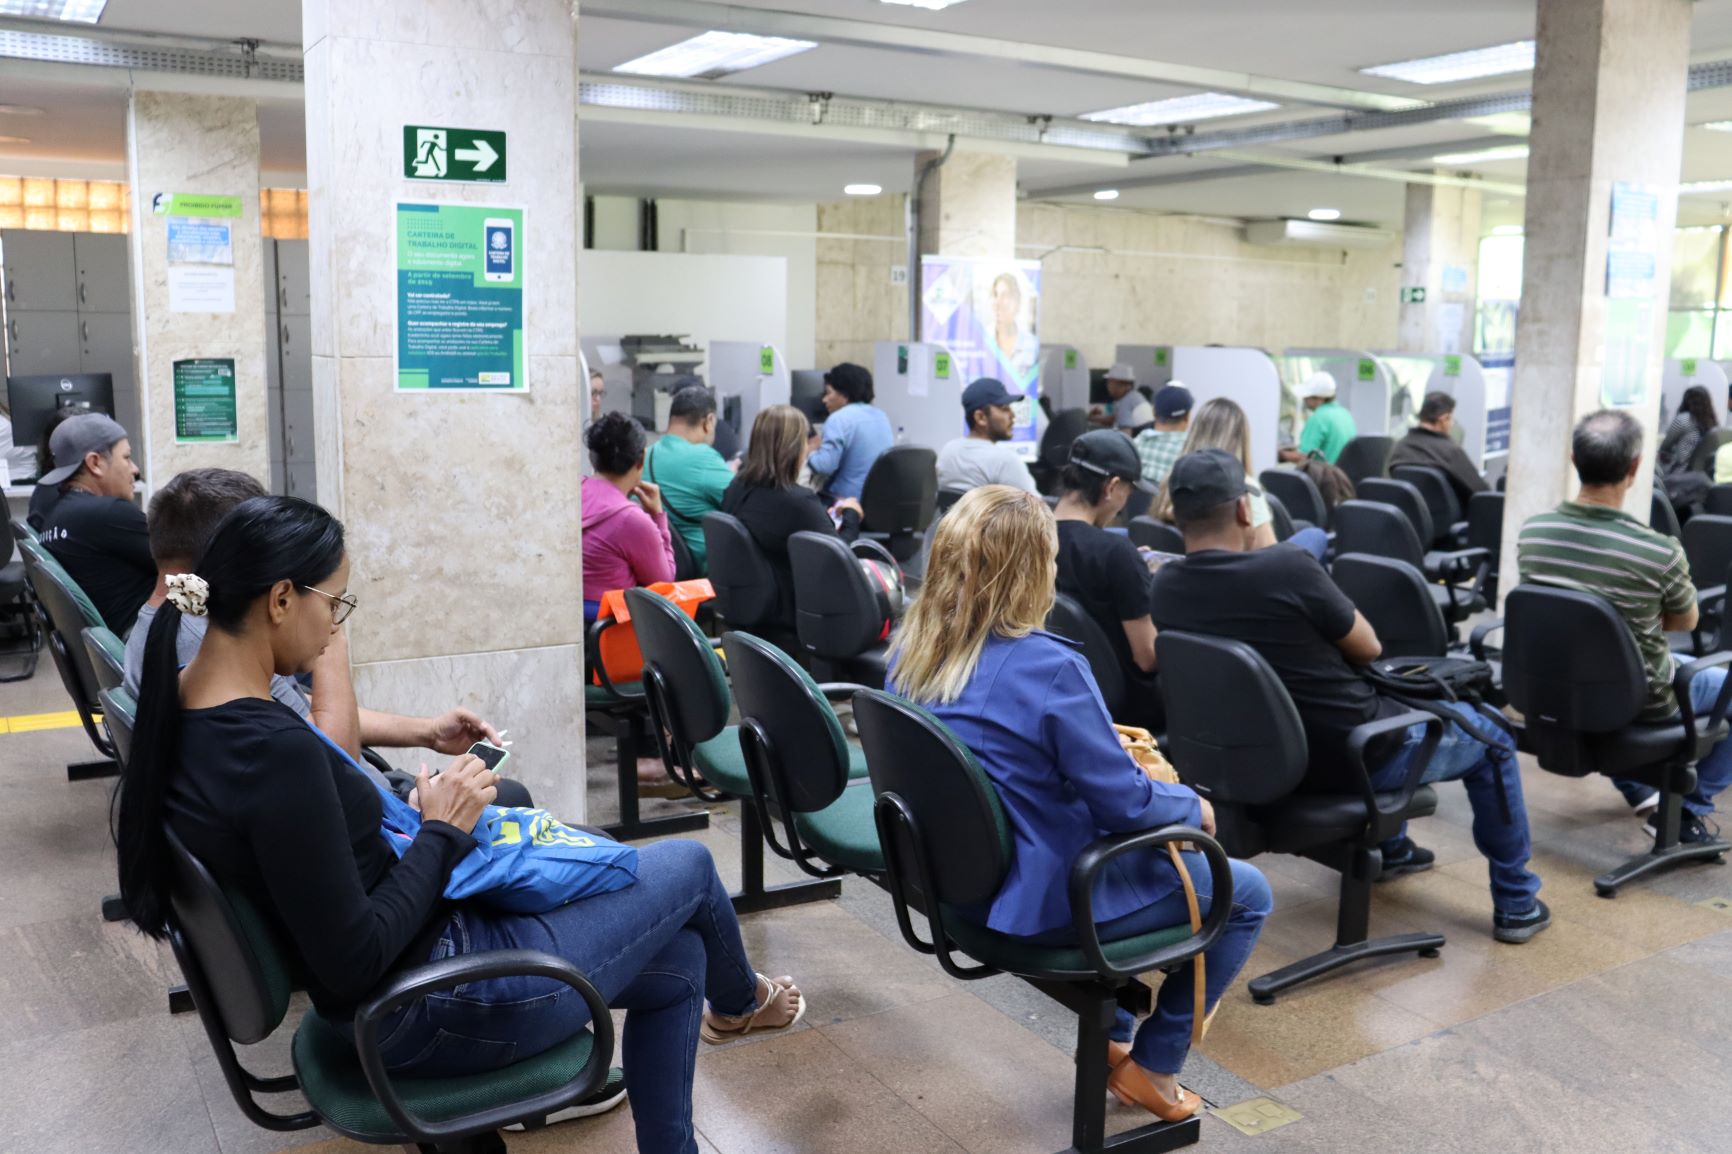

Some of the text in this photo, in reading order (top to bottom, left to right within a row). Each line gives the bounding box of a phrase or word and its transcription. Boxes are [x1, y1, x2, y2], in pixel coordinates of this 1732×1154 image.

[407, 231, 444, 239] CARTEIRA
[407, 240, 478, 250] TRABALHO DIGITAL
[936, 359, 948, 371] 07
